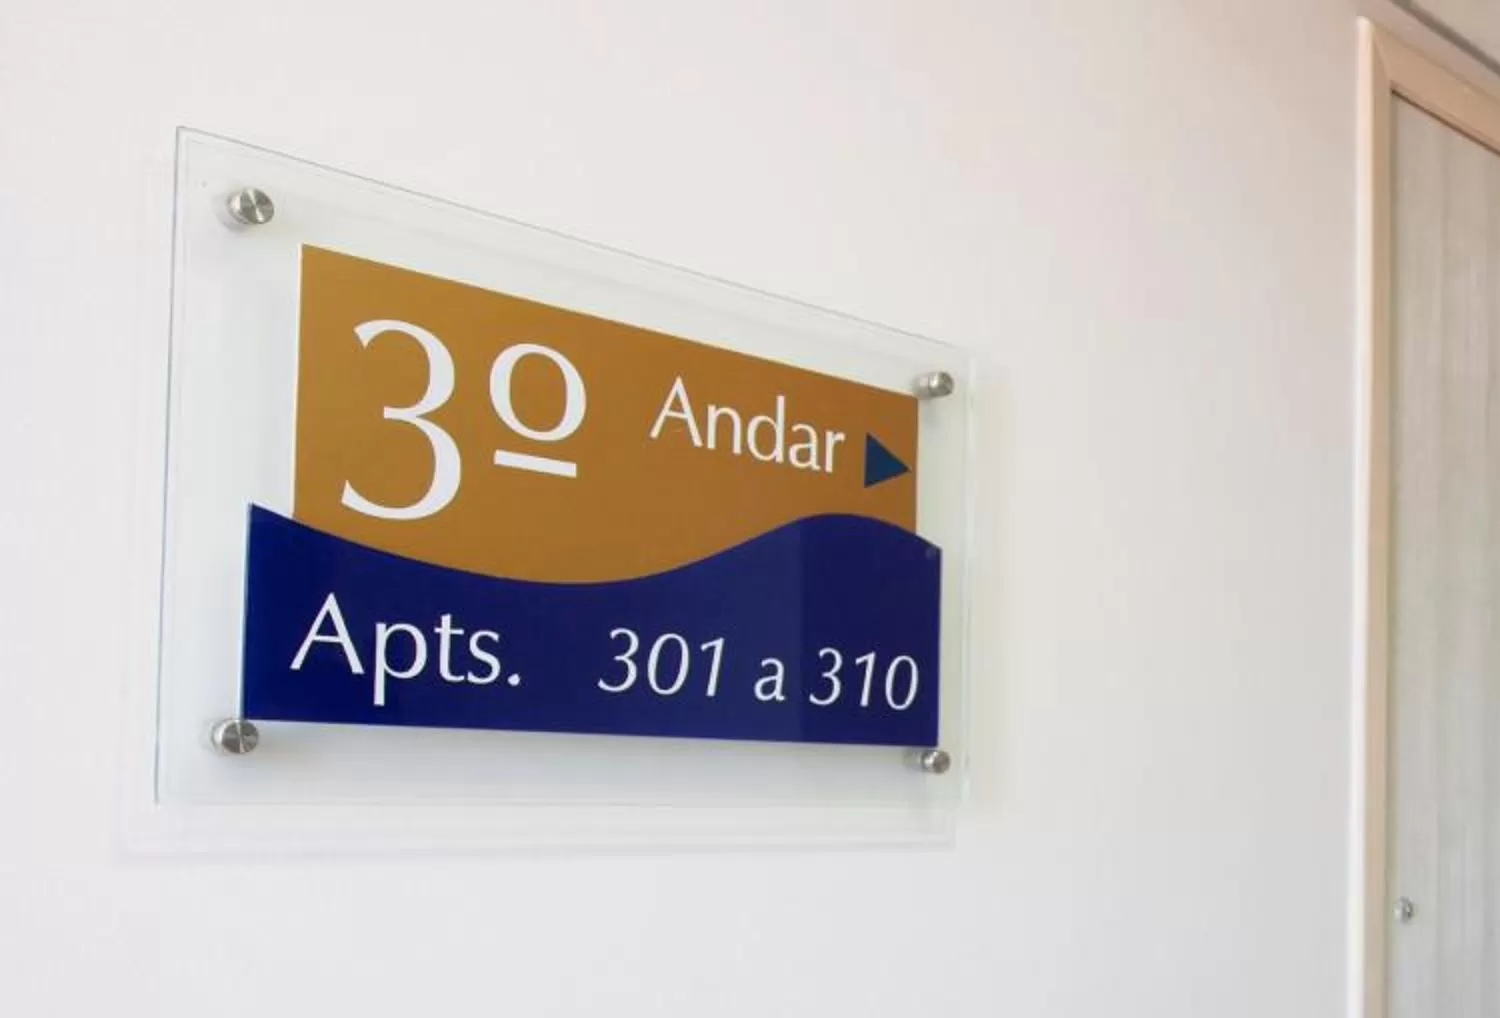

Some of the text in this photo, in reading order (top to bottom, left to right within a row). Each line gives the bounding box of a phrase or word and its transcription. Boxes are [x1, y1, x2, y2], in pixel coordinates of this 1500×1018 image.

[650, 375, 846, 473] Andar
[290, 591, 919, 711] Apts. 301 a 310
